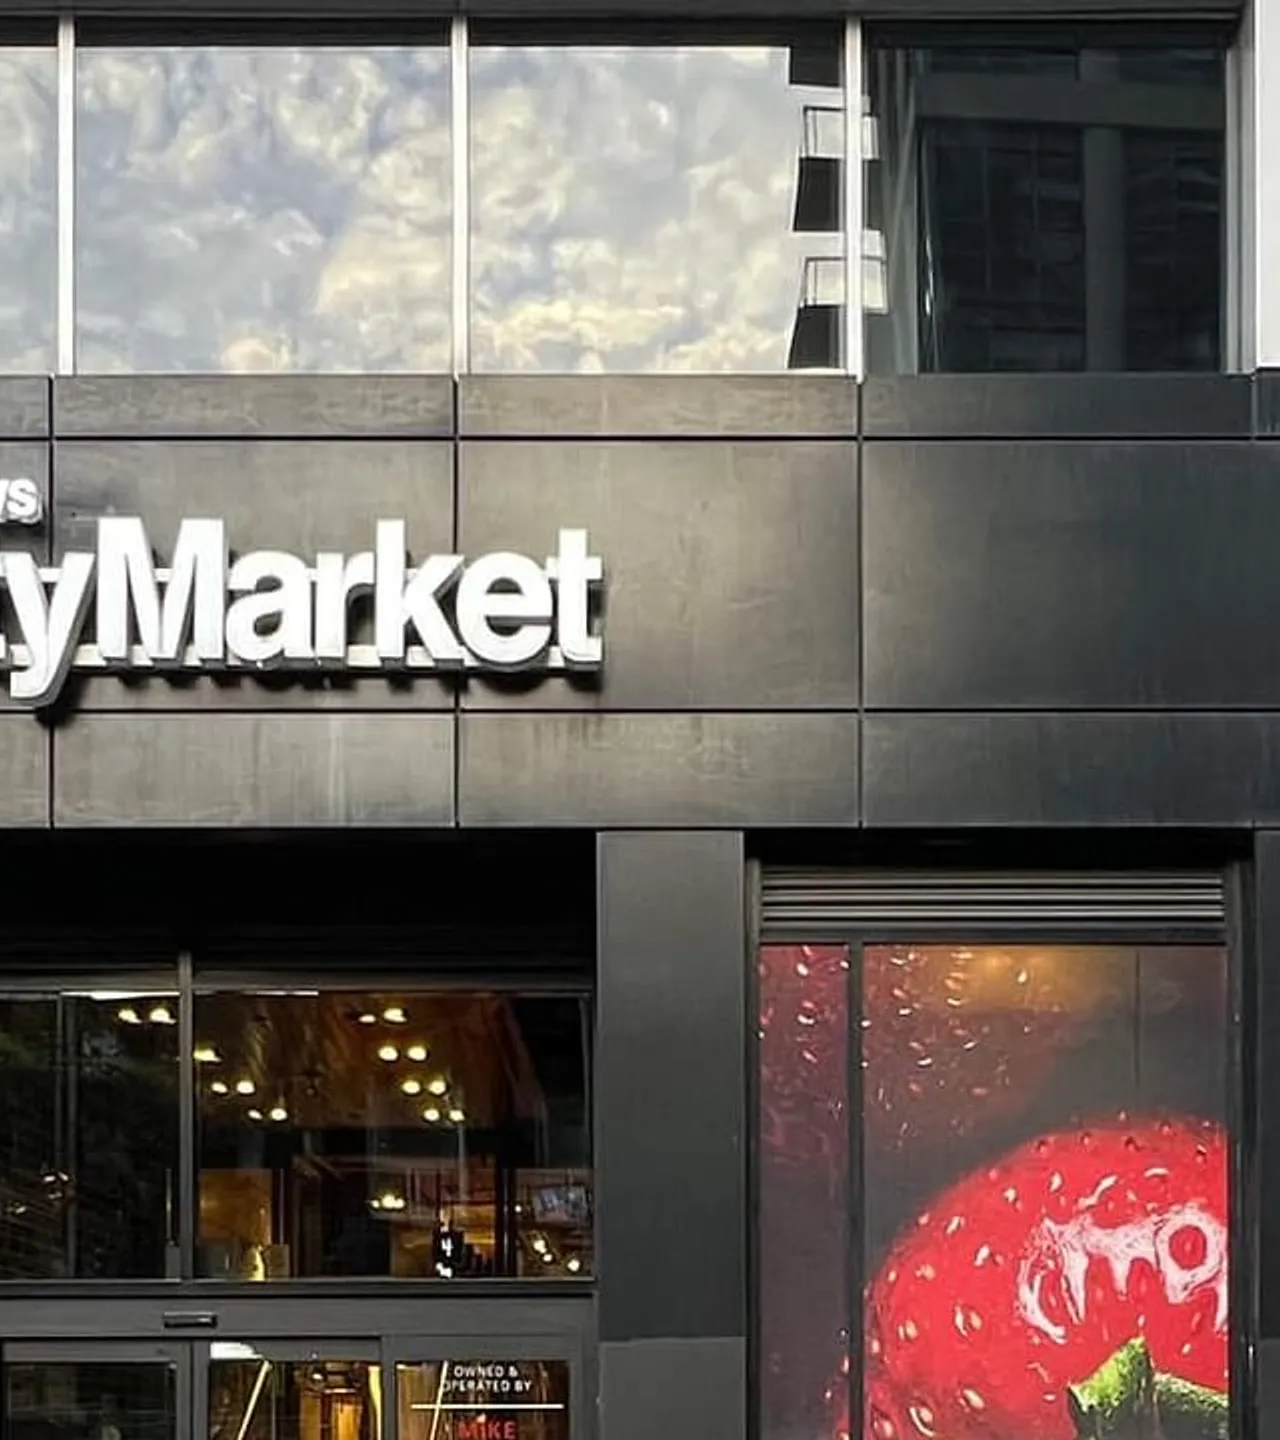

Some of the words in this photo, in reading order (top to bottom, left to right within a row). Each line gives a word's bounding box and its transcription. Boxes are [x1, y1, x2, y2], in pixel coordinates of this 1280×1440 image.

[454, 1365, 504, 1377] OWNED
[442, 1380, 510, 1392] OPERATED
[514, 1380, 532, 1392] BY
[458, 1421, 516, 1440] MIKE
